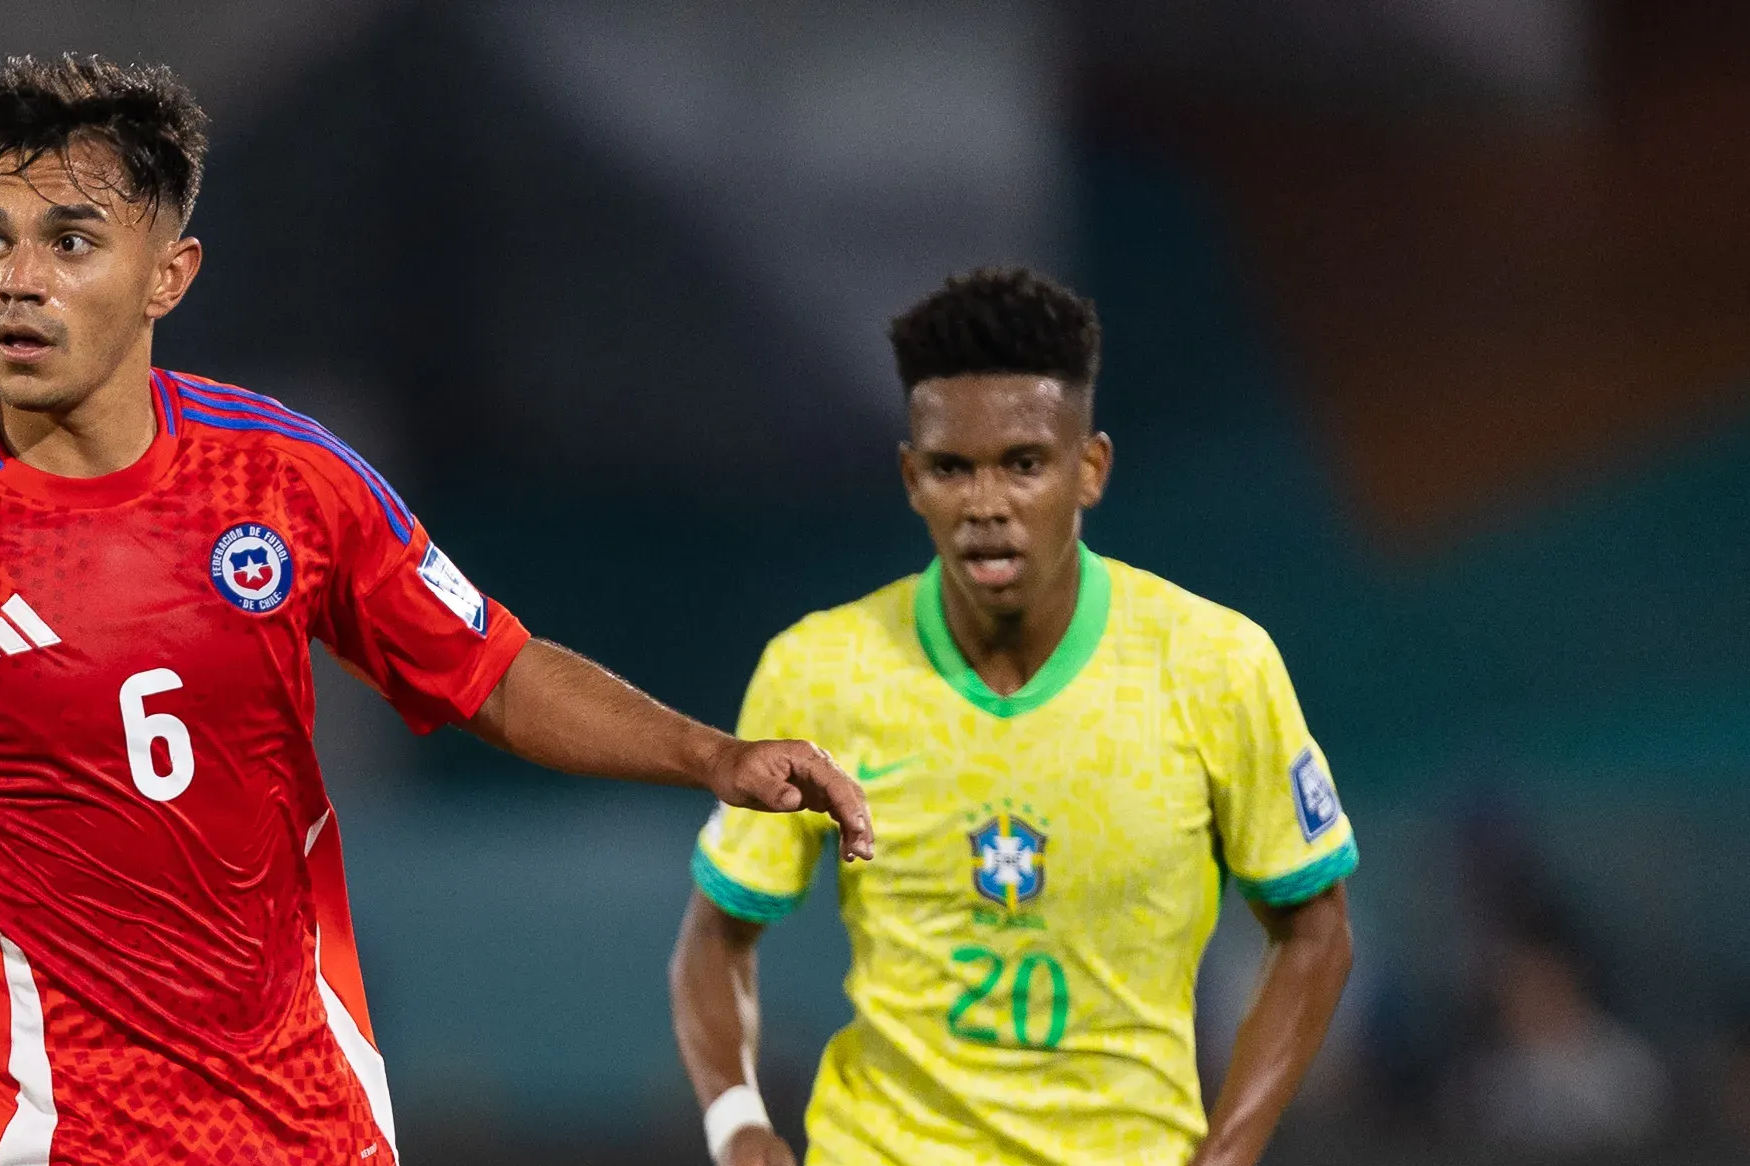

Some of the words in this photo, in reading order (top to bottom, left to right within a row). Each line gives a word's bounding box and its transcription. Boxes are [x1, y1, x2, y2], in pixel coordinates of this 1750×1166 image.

[212, 527, 244, 577] FEDERACION
[250, 526, 261, 537] DE
[264, 532, 289, 563] FUTBOL
[243, 599, 255, 610] DE
[259, 591, 282, 609] CHILE
[119, 667, 195, 801] 6
[947, 943, 1070, 1050] 20
